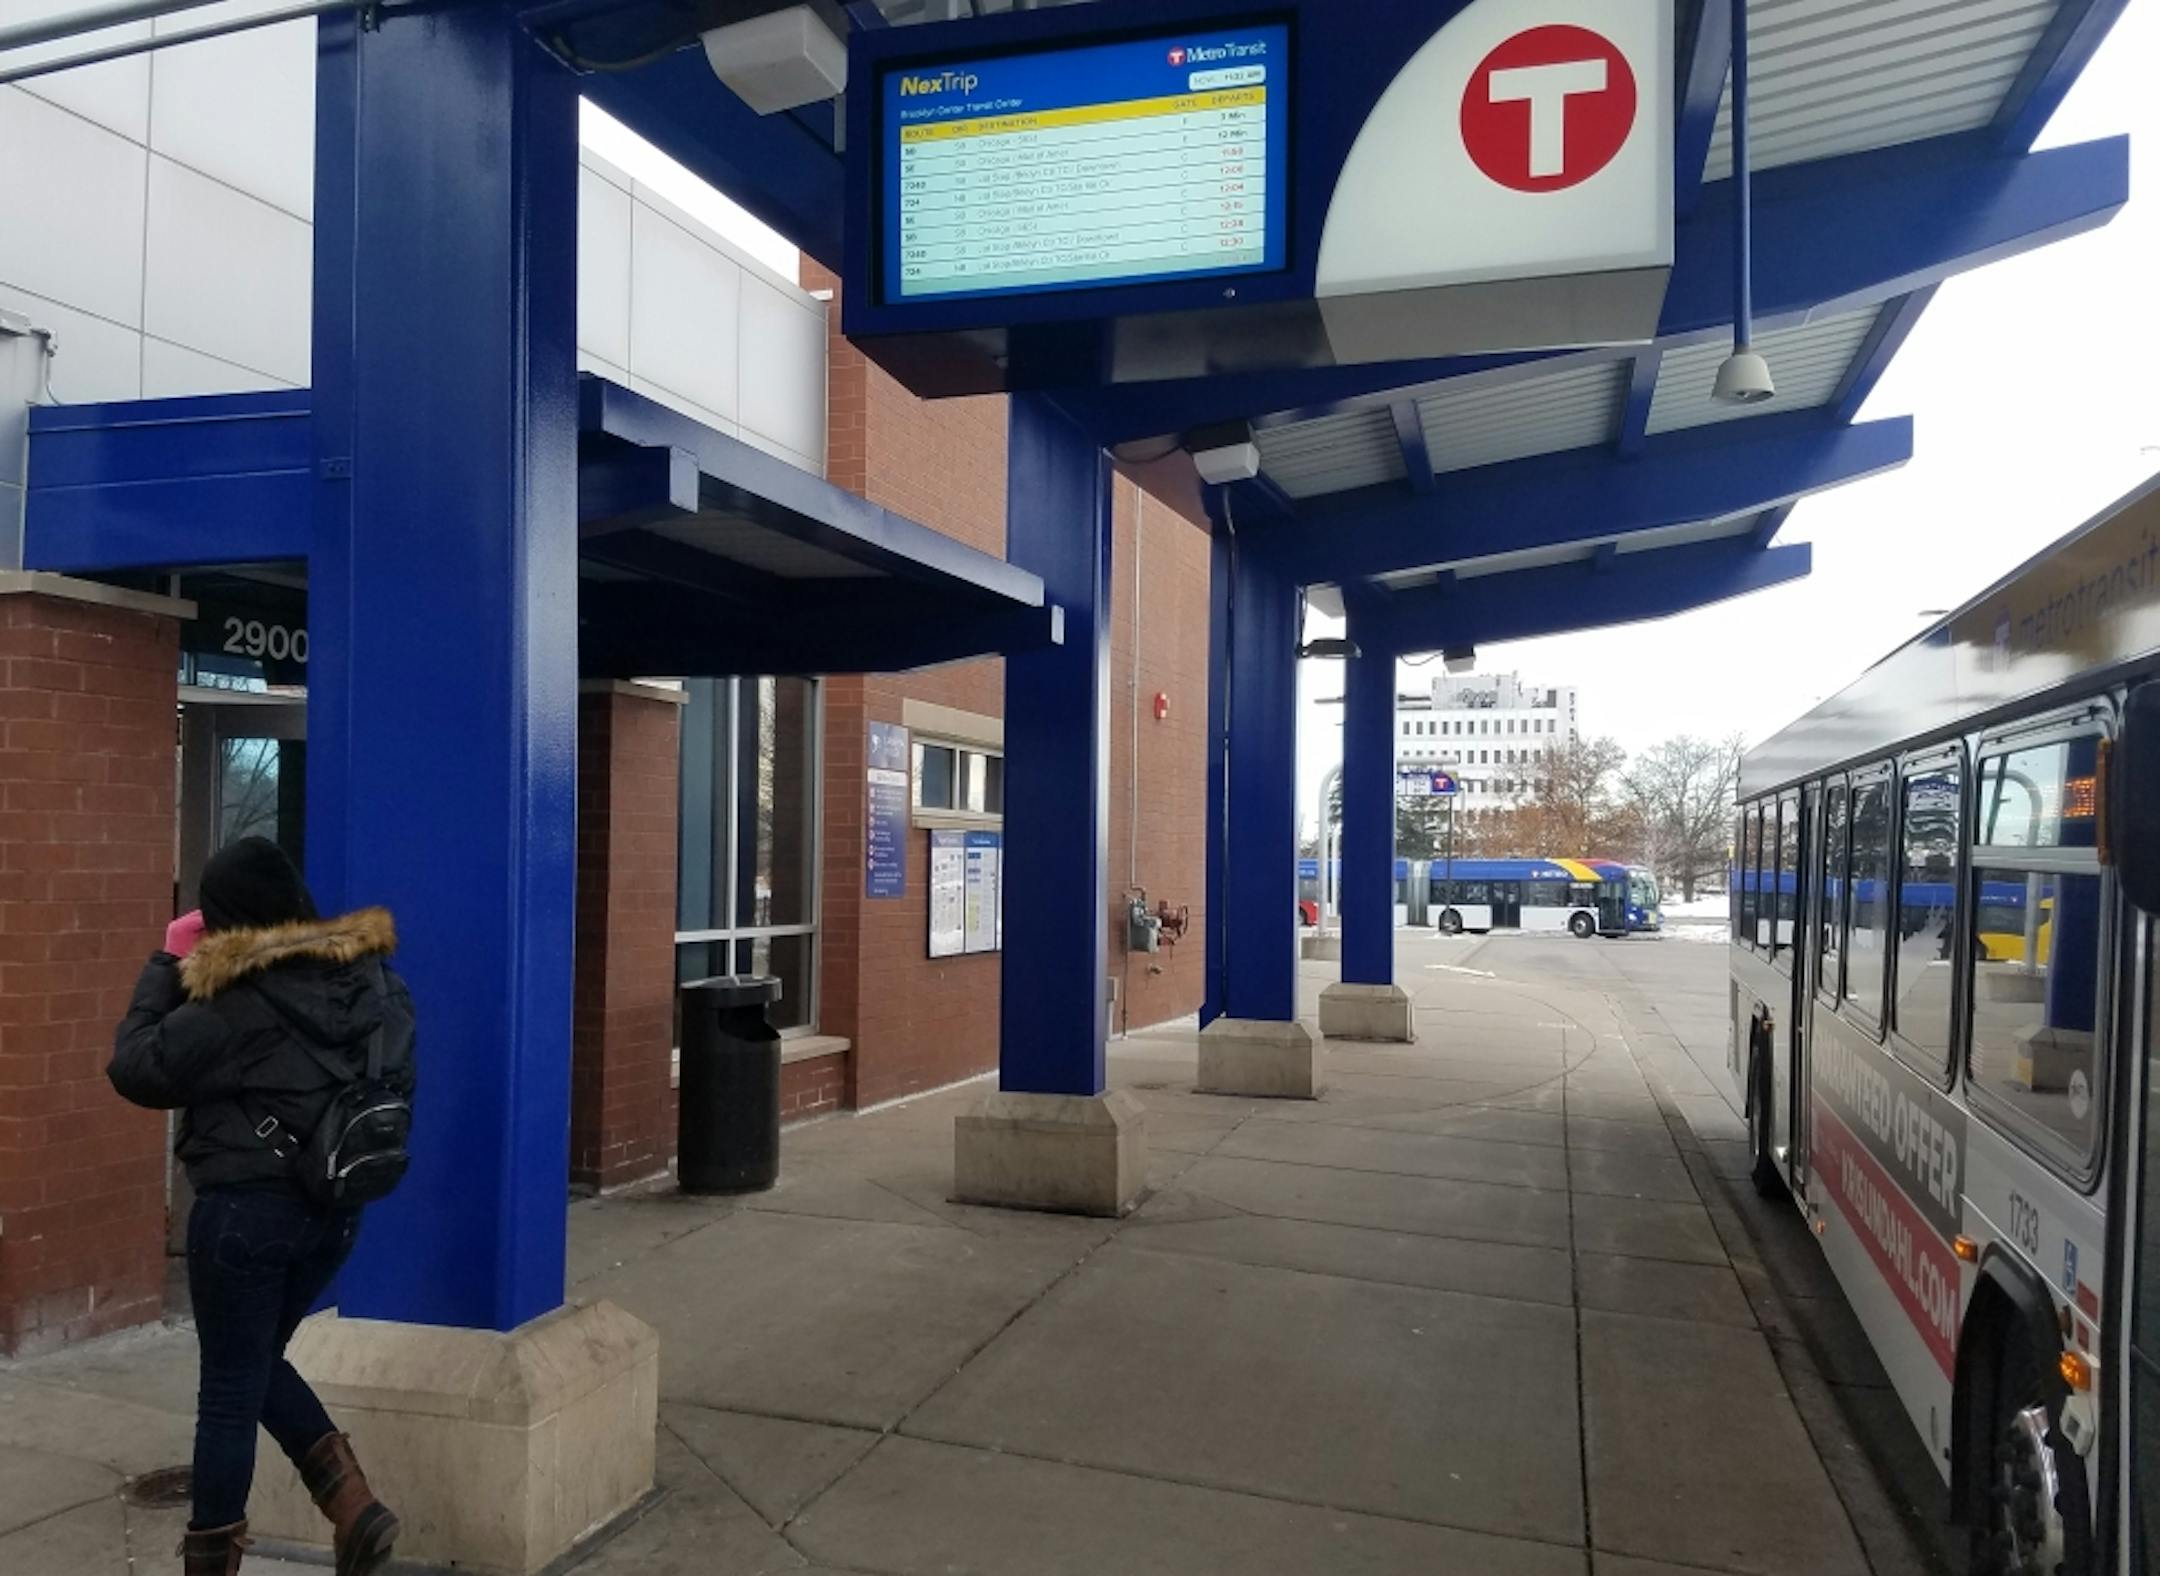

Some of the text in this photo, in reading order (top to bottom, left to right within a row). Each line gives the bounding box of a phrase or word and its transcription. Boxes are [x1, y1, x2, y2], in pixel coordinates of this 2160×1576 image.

[900, 71, 978, 97] NexTrip
[937, 105, 964, 116] Center
[967, 101, 993, 112] Transit
[994, 98, 1023, 109] Center
[1489, 58, 1607, 178] T
[224, 616, 310, 663] 2900
[1894, 1091, 1958, 1219] OFFER
[2008, 1189, 2039, 1256] 1733
